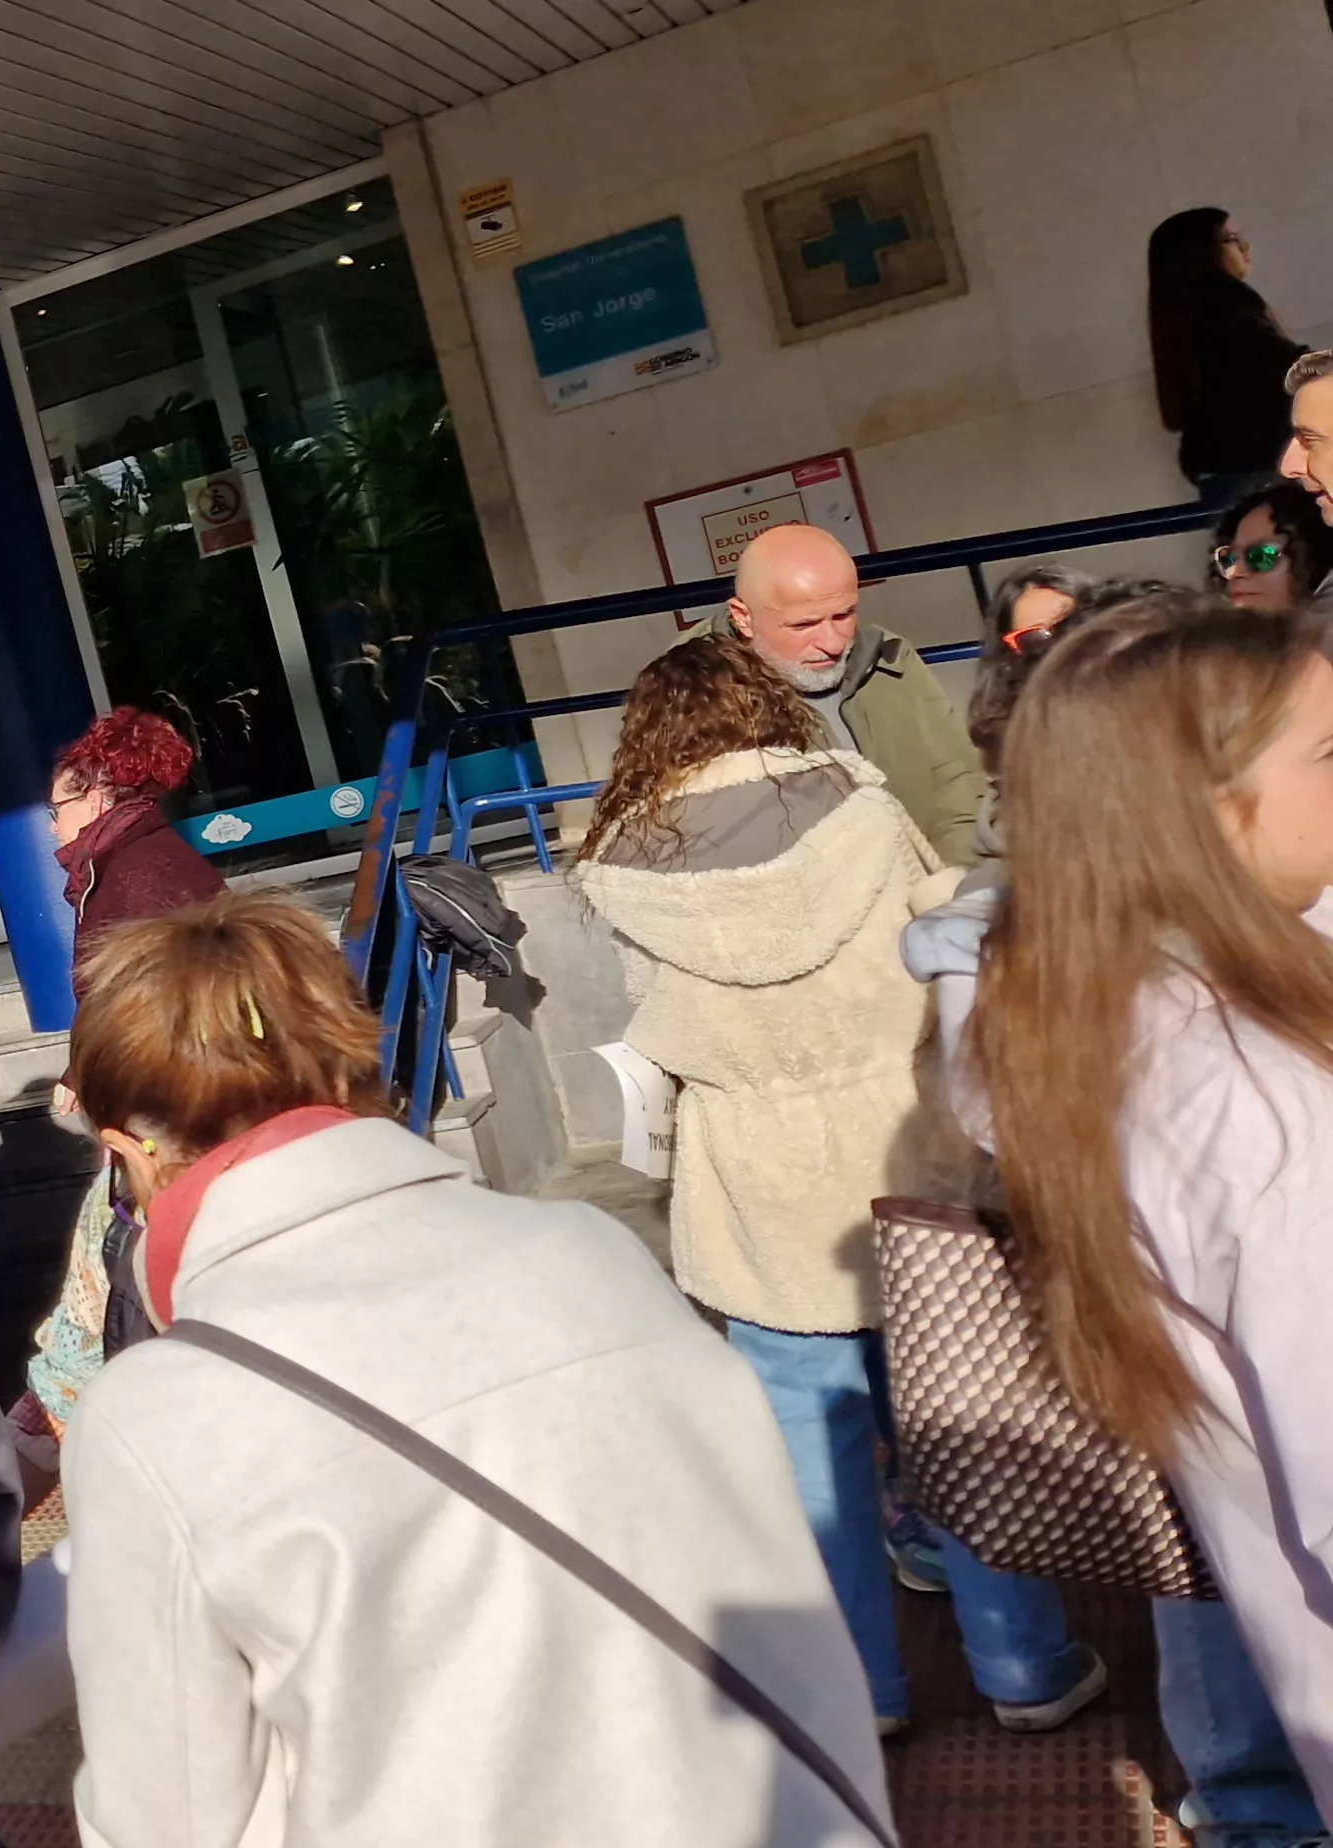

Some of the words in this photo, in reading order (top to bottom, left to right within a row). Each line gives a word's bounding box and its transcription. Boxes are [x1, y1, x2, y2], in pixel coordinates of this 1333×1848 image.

[541, 310, 583, 333] San
[593, 288, 657, 318] Jorge
[737, 510, 770, 526] USO
